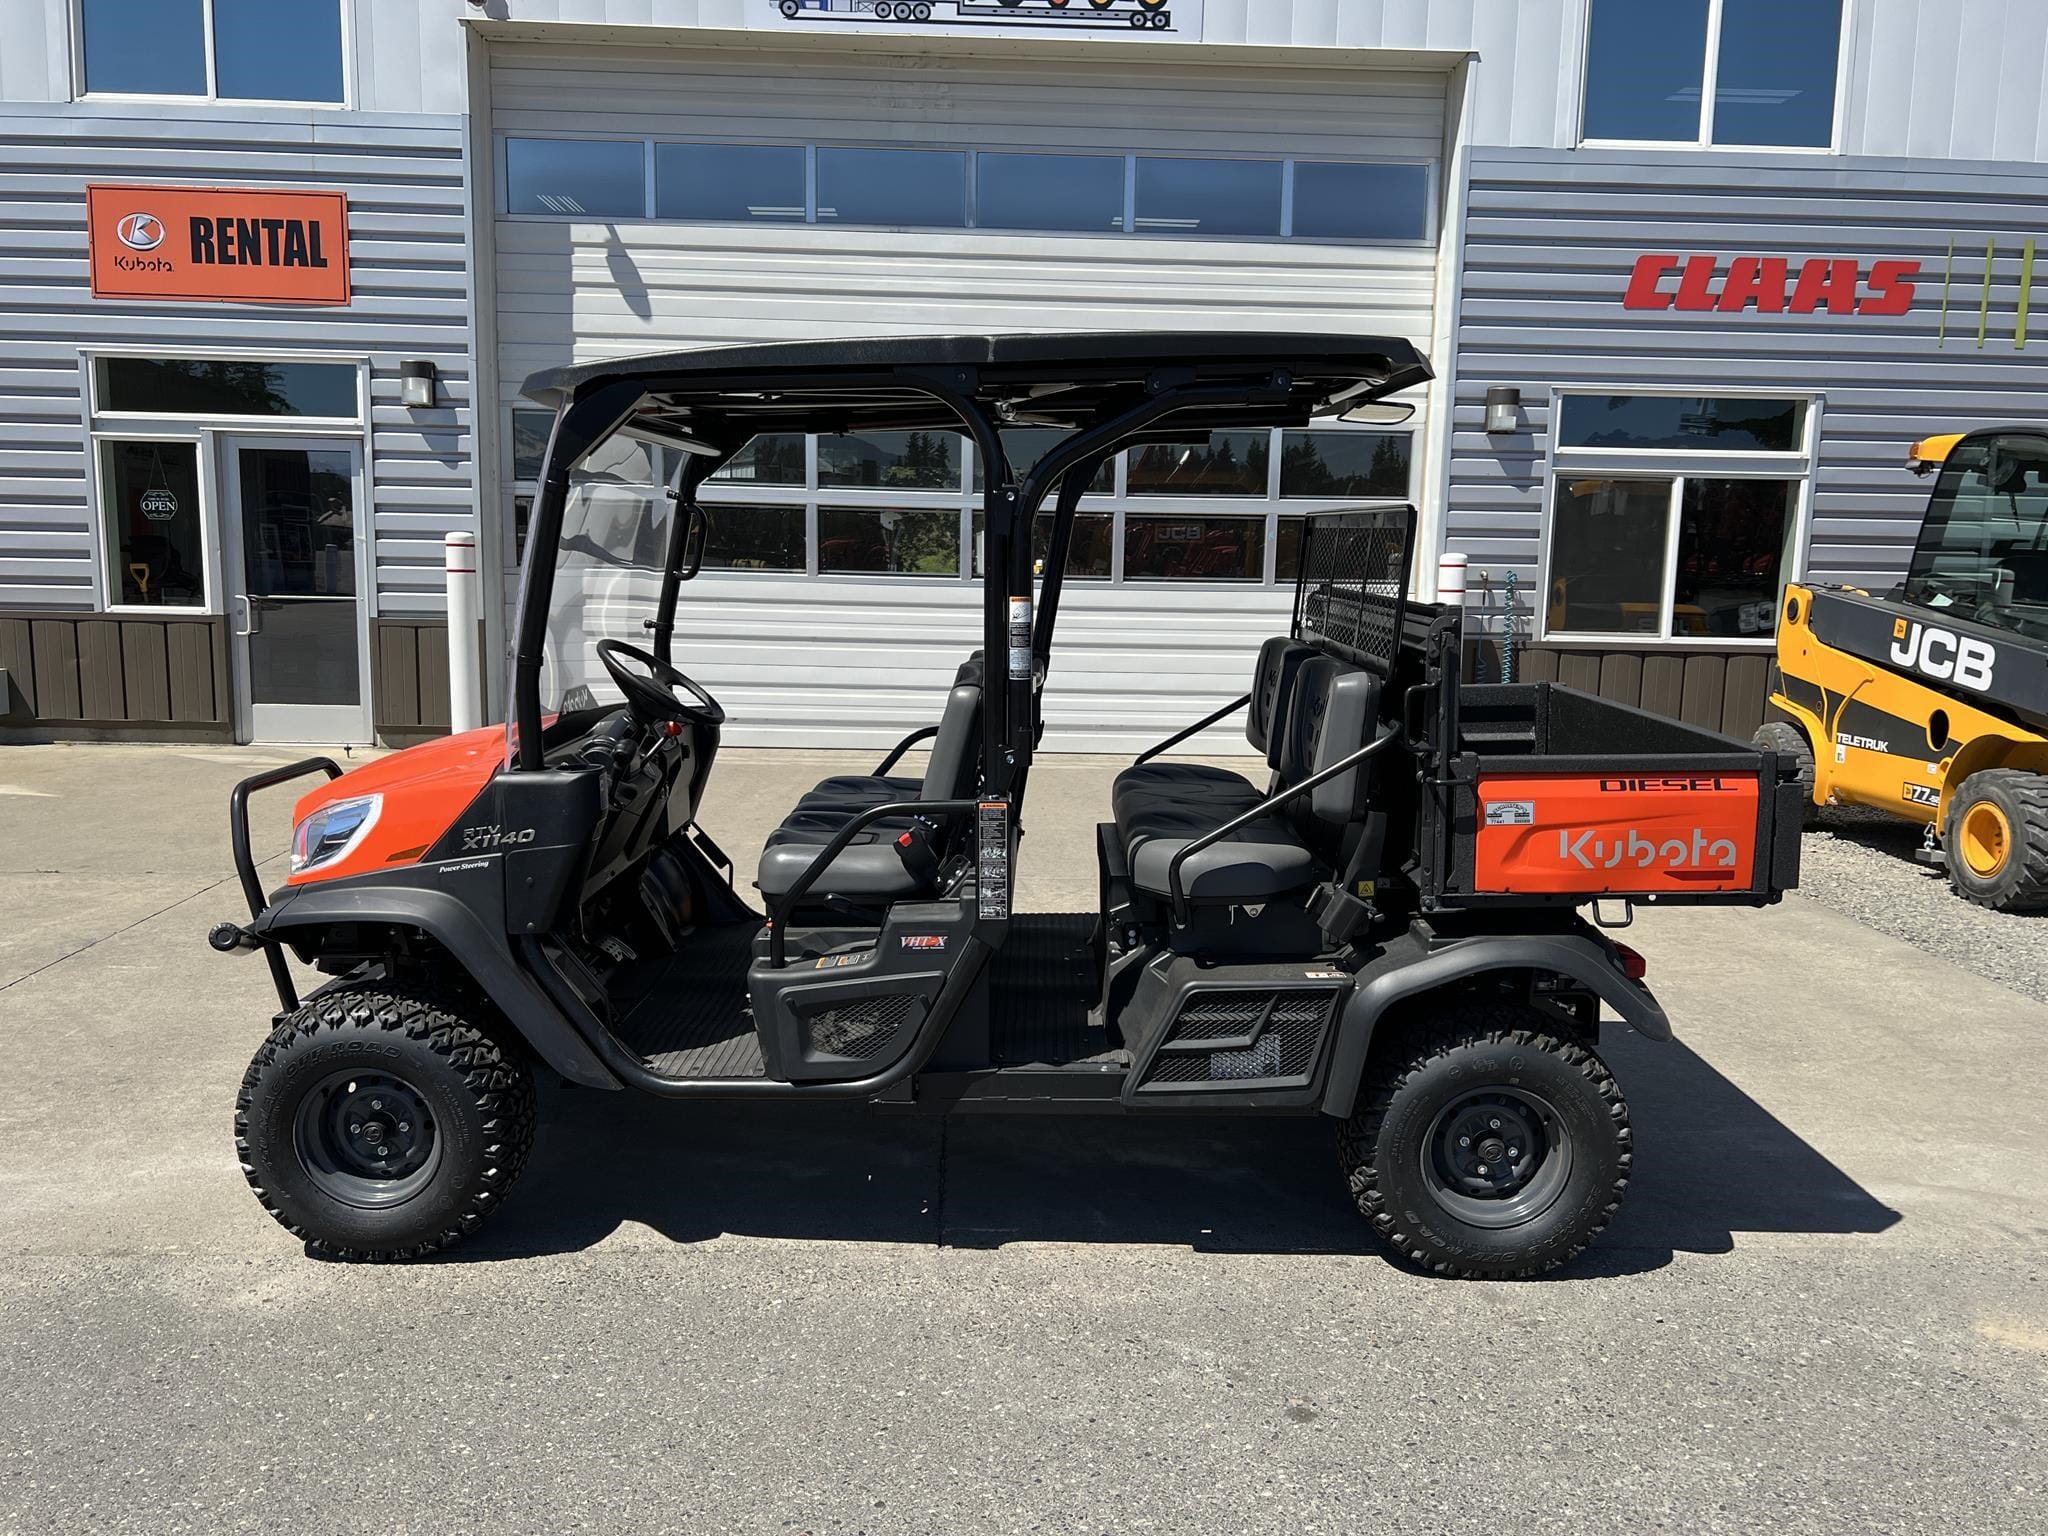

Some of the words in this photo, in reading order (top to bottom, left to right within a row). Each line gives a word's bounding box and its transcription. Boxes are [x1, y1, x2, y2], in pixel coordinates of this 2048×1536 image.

[189, 216, 328, 268] RENTAL
[114, 255, 174, 272] Kubota
[1623, 255, 1921, 316] CLAAS
[142, 501, 175, 511] OPEN
[1159, 527, 1200, 539] JCB
[1890, 622, 1996, 692] JCB
[1836, 732, 1888, 753] TELETRUK
[1600, 779, 1738, 792] DIESEL
[461, 828, 536, 850] X1140
[463, 825, 500, 837] RTV
[1559, 828, 1737, 869] Kubota
[461, 861, 489, 870] Steering
[286, 1045, 325, 1078] OFF
[330, 1040, 402, 1059] ROAD
